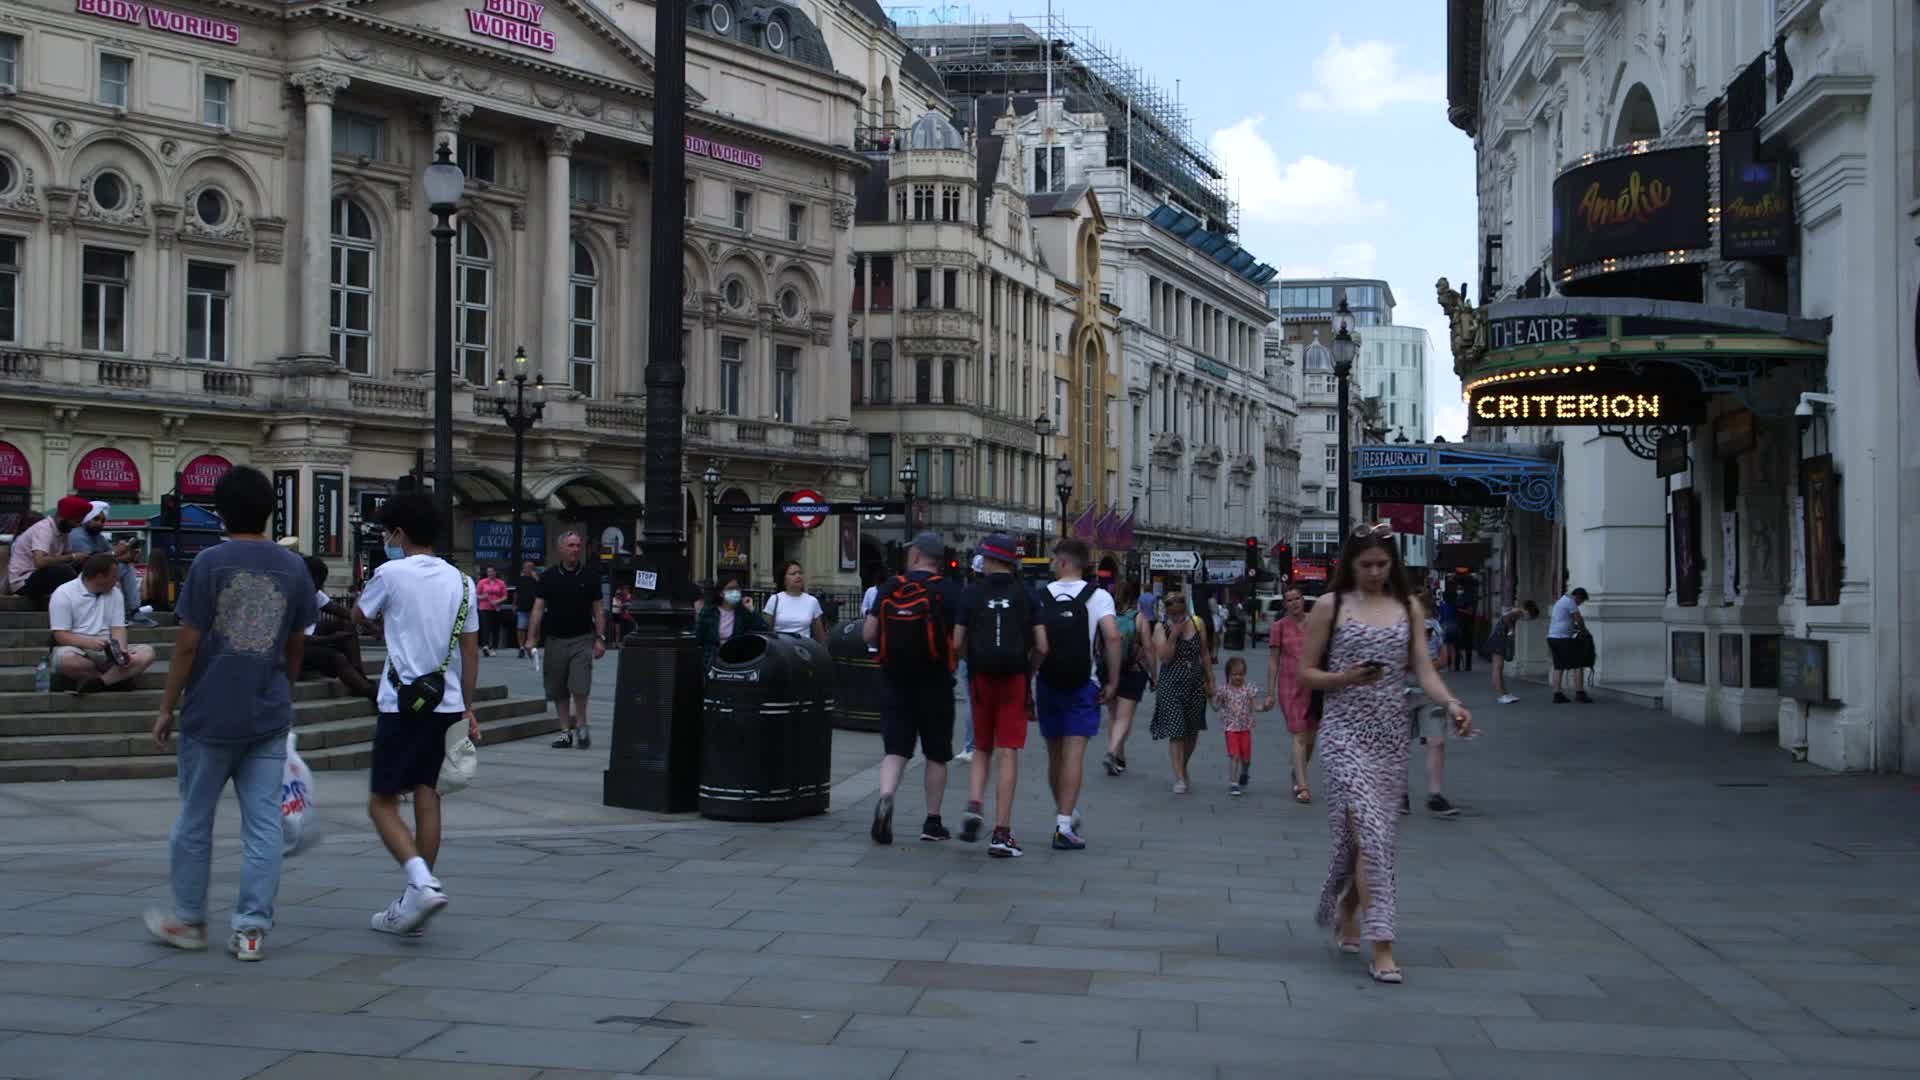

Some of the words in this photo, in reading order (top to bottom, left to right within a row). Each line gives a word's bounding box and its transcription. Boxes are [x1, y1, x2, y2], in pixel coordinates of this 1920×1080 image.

[79, 0, 145, 24] BODY
[148, 7, 241, 44] WORLDS
[486, 0, 544, 25] BODY
[470, 10, 556, 52] WORLDS
[711, 142, 763, 169] WORLDS
[1491, 318, 1578, 348] THEATRE
[1475, 394, 1661, 420] CRITERION
[91, 459, 125, 470] BODY
[1363, 451, 1425, 467] RESTAURANT
[81, 469, 134, 481] WORLDS
[782, 504, 830, 513] UNDERGROUND
